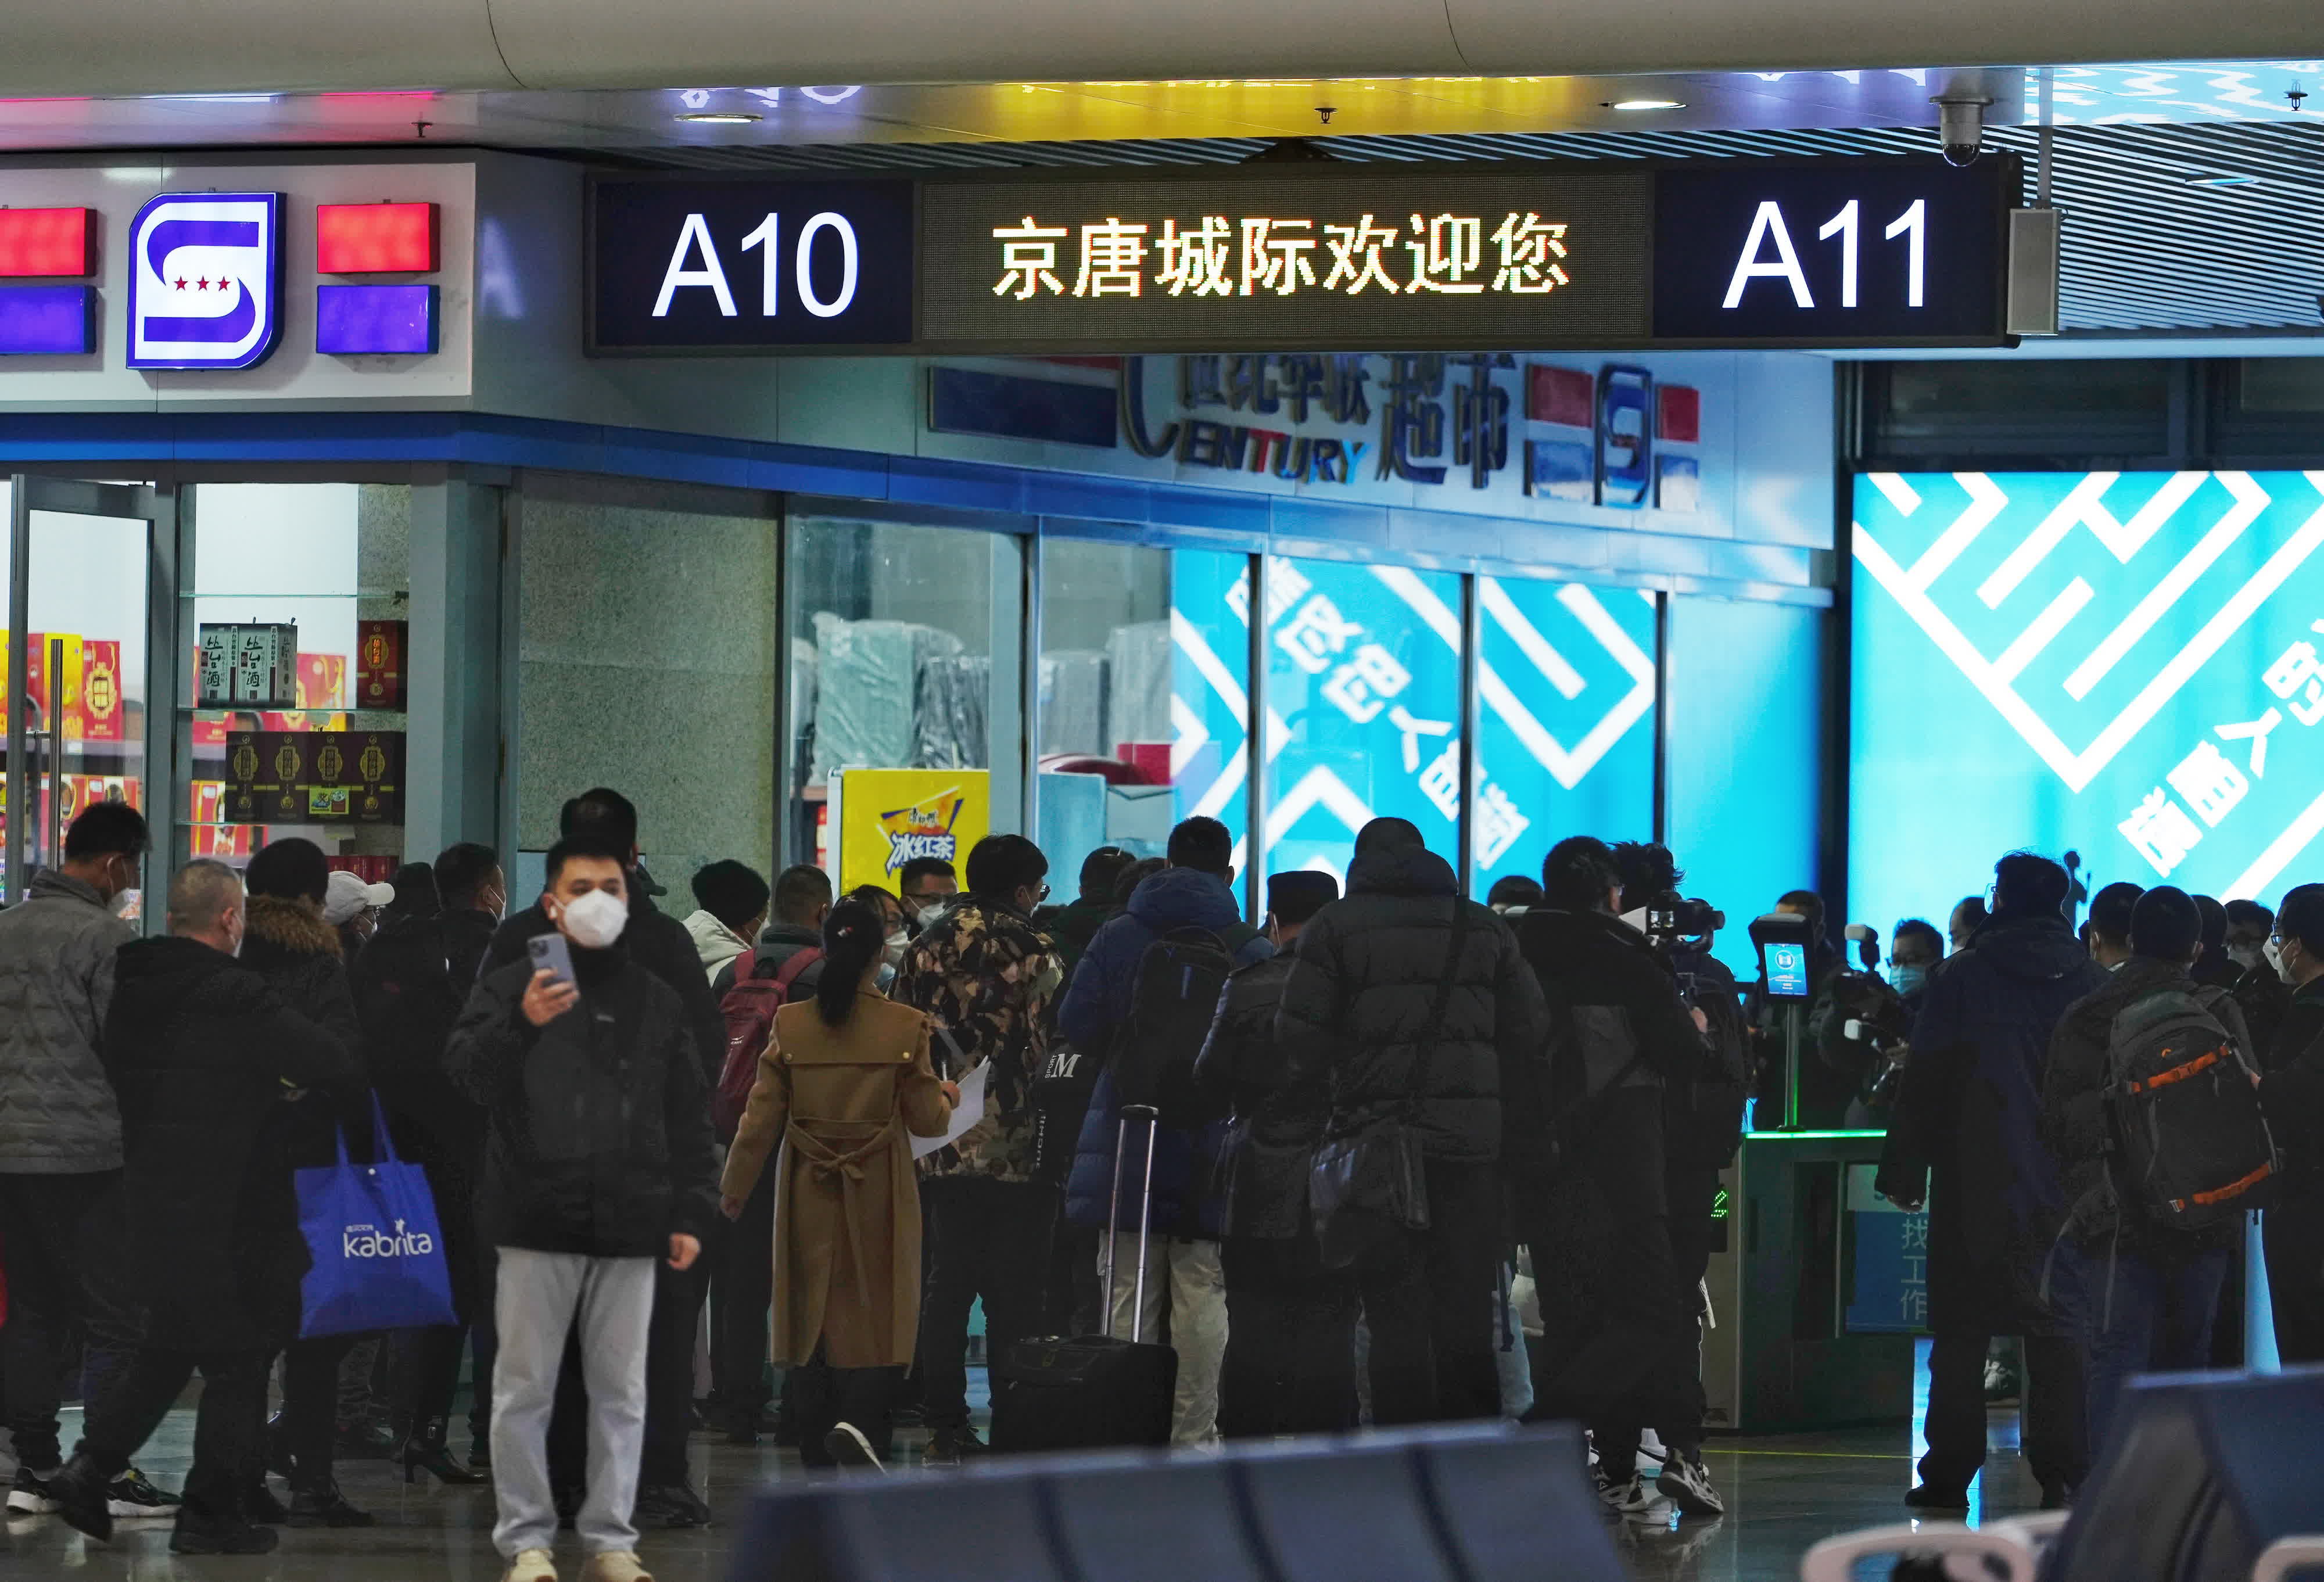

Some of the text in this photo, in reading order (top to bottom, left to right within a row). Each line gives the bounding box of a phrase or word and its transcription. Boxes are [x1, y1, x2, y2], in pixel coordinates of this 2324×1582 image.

[652, 212, 859, 318] A10
[991, 213, 1569, 300] 京唐城际欢迎您
[1722, 199, 1925, 308] A11
[343, 1227, 433, 1258] kabrita
